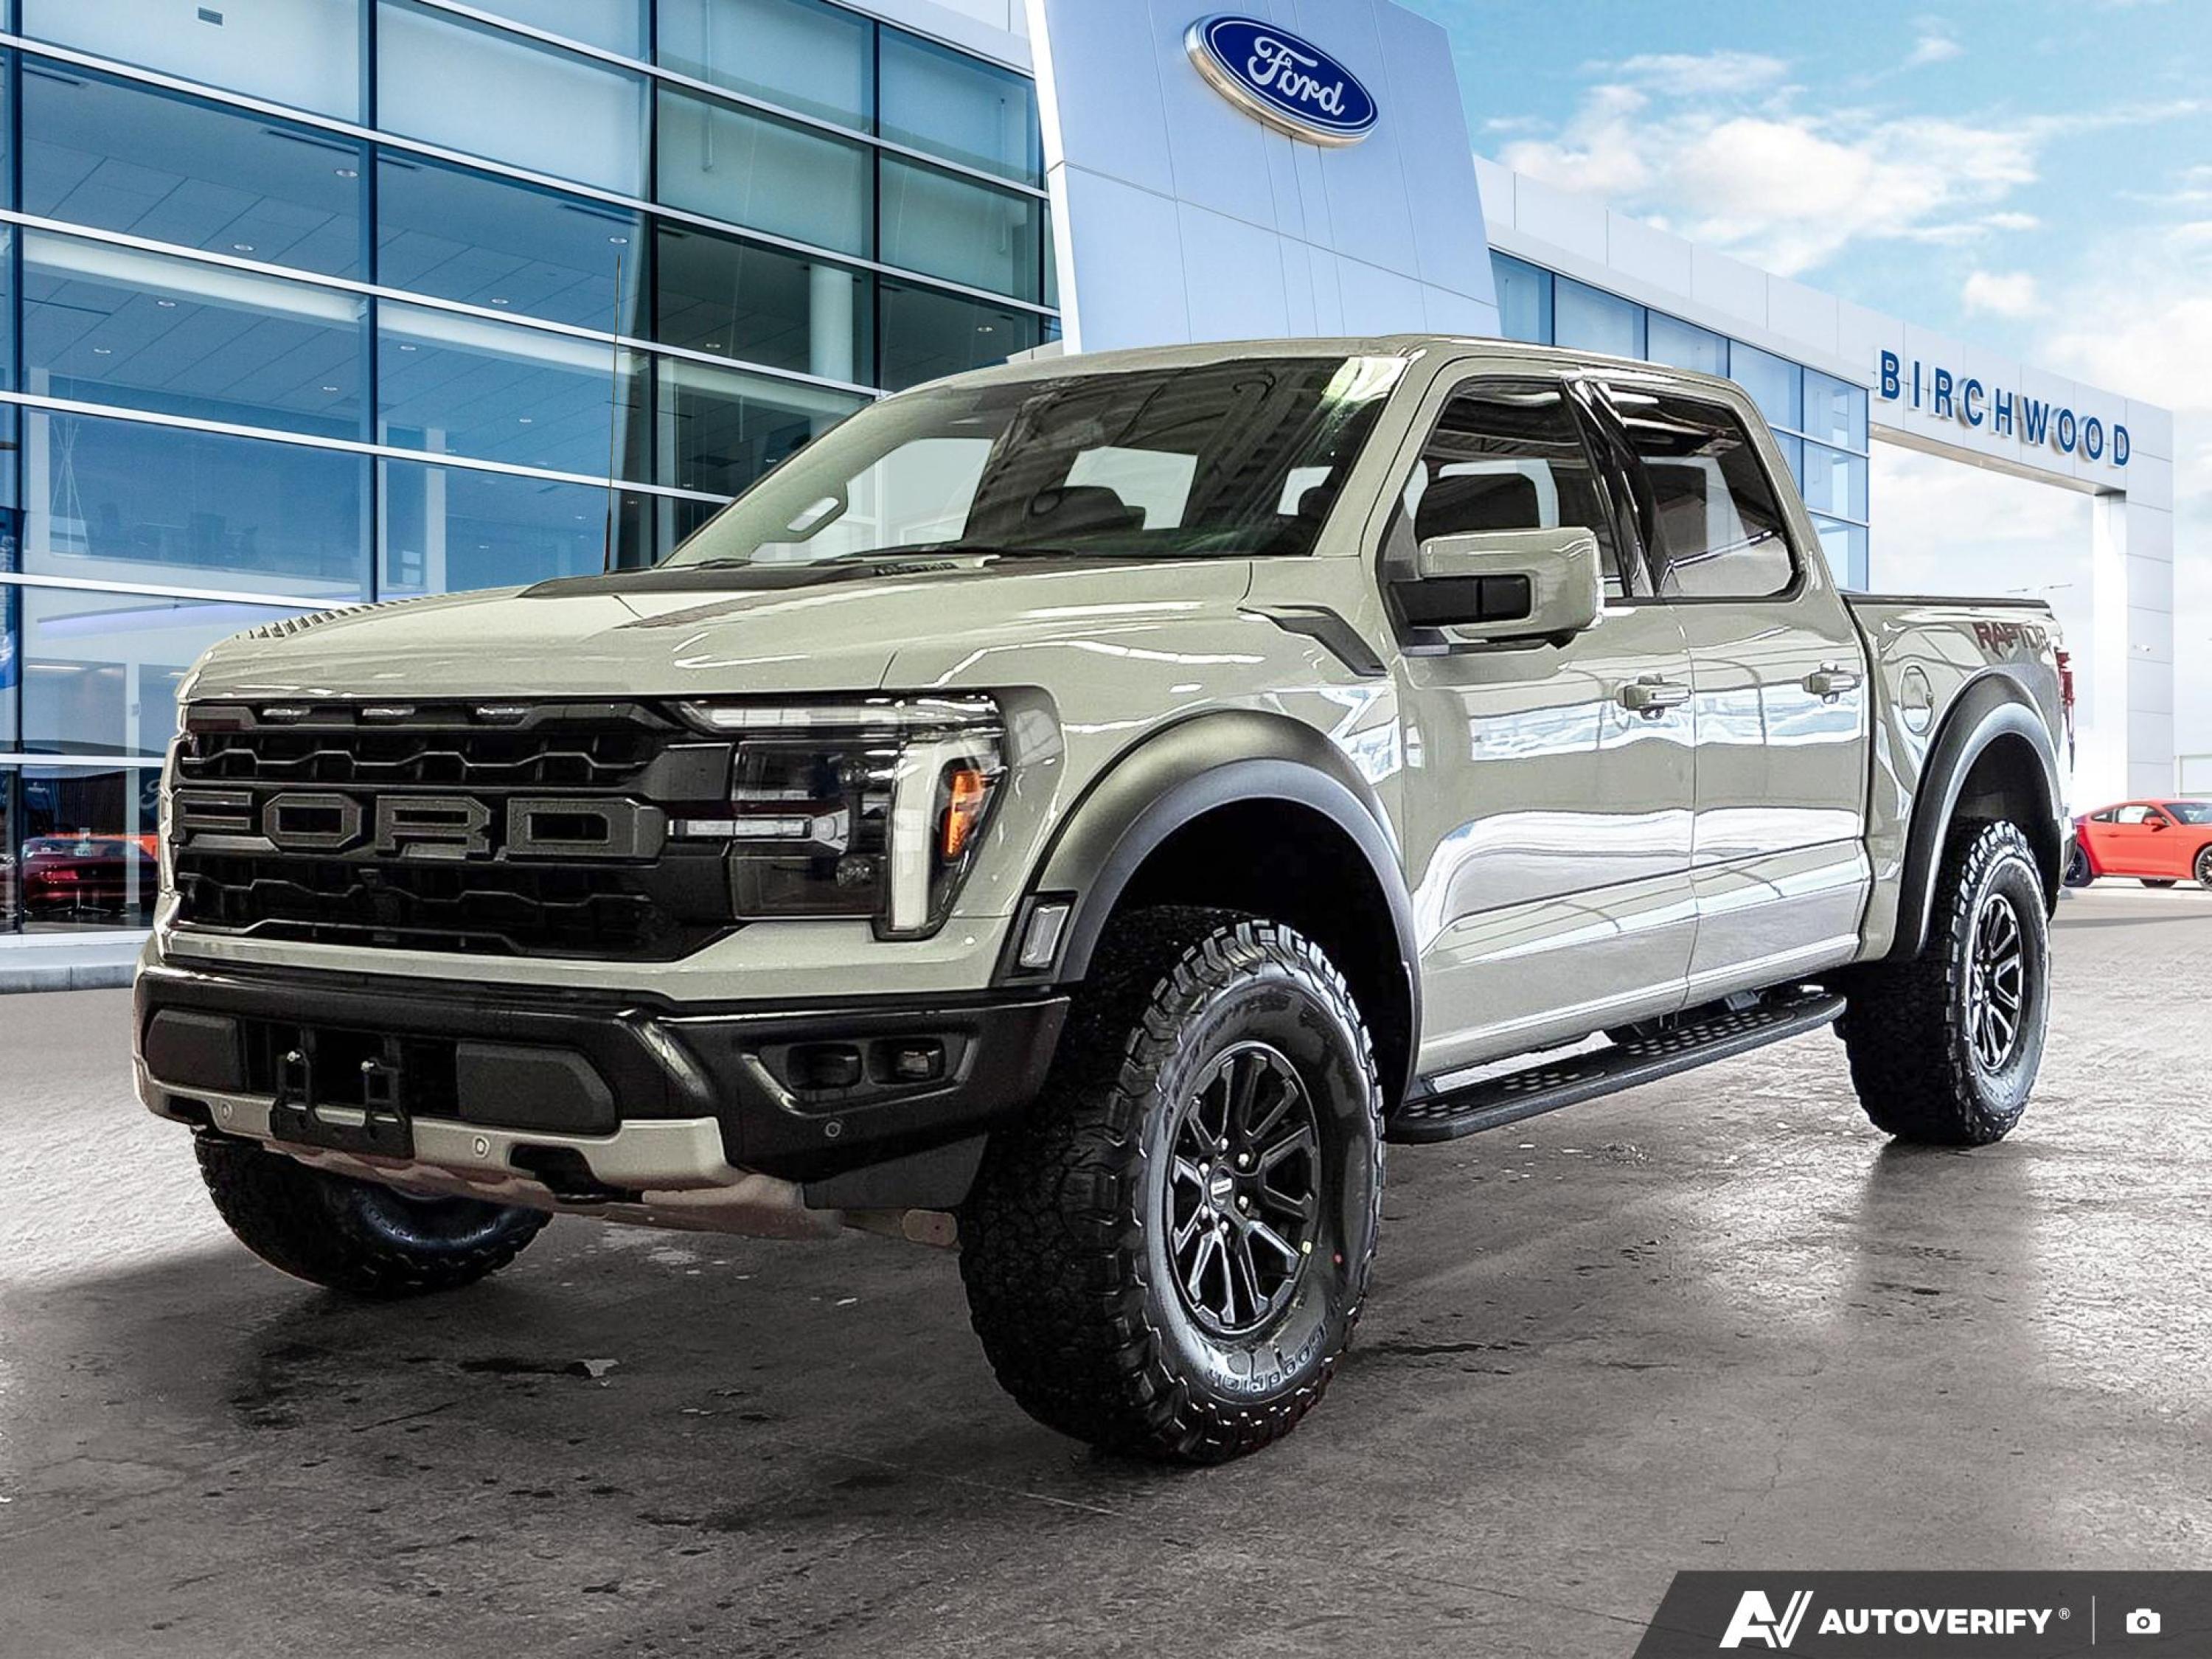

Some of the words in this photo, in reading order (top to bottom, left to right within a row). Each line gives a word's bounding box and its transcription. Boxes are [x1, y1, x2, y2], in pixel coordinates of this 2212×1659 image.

[1247, 35, 1346, 116] Ford
[1880, 349, 2130, 466] BIRCHWOOD
[170, 787, 664, 859] FORD
